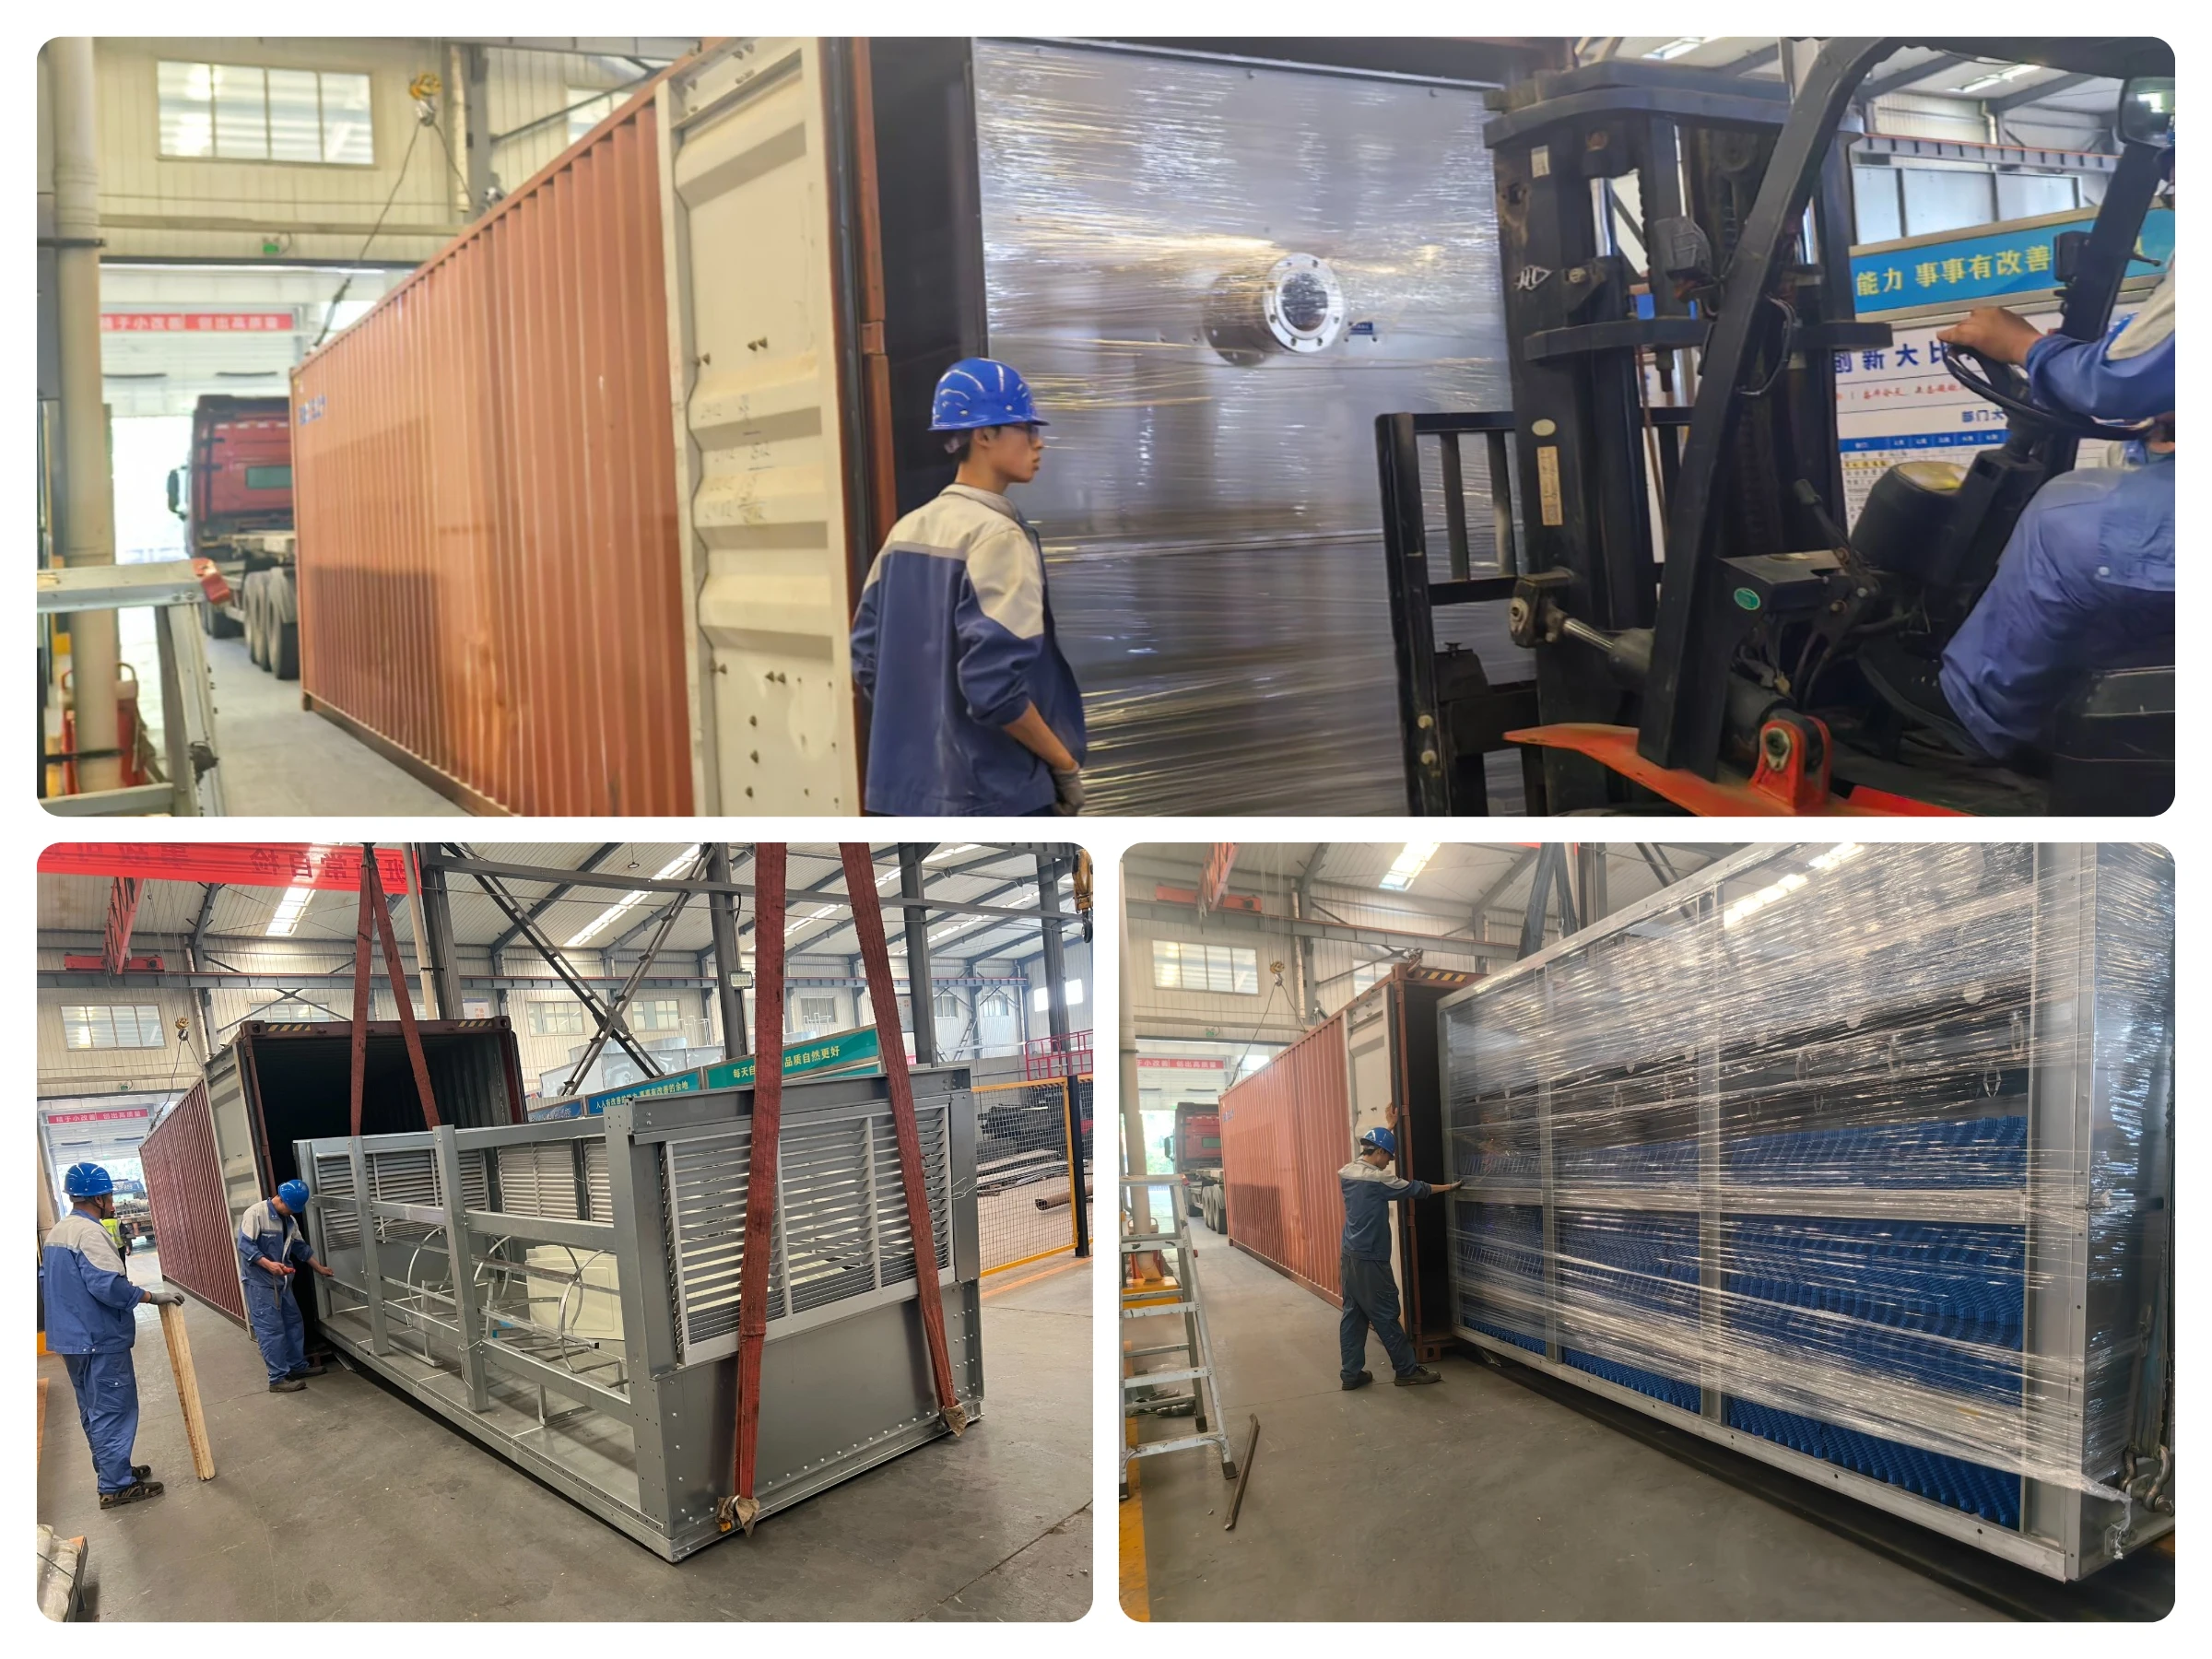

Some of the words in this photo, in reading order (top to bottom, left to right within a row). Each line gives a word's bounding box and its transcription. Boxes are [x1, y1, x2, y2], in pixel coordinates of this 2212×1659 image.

[1856, 268, 1903, 296] 能力
[1914, 244, 2052, 288] 事事有改善
[784, 1045, 841, 1067] 品质自然更好
